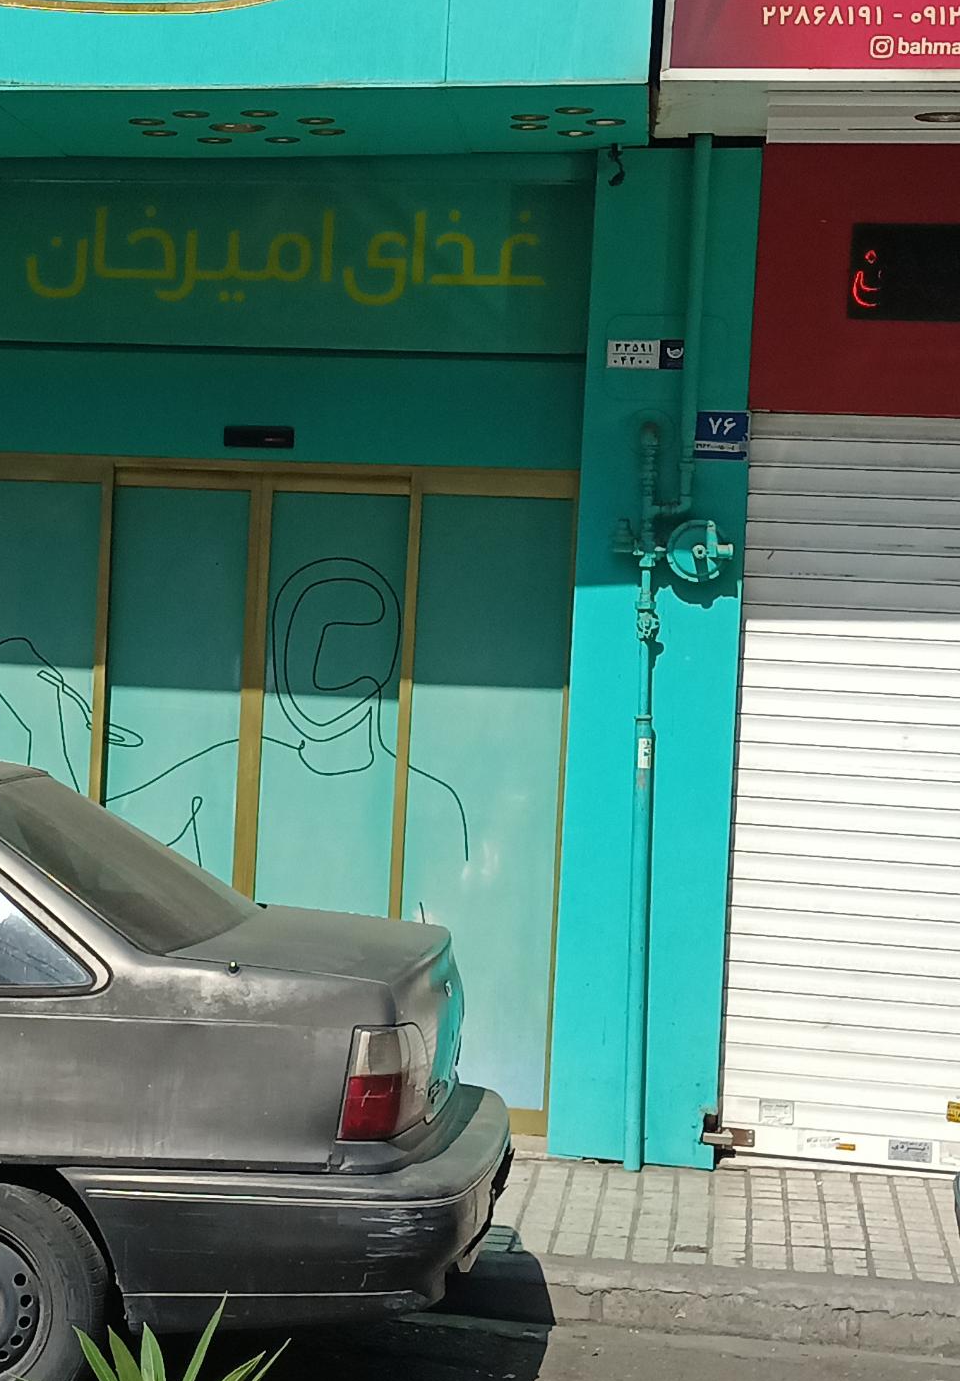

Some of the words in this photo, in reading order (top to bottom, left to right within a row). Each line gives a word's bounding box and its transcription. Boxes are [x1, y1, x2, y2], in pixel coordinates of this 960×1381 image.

[762, 5, 882, 25] ۲۲۸۶۸۱۹۱
[342, 209, 547, 306] غذای
[708, 417, 737, 435] ۷۶
